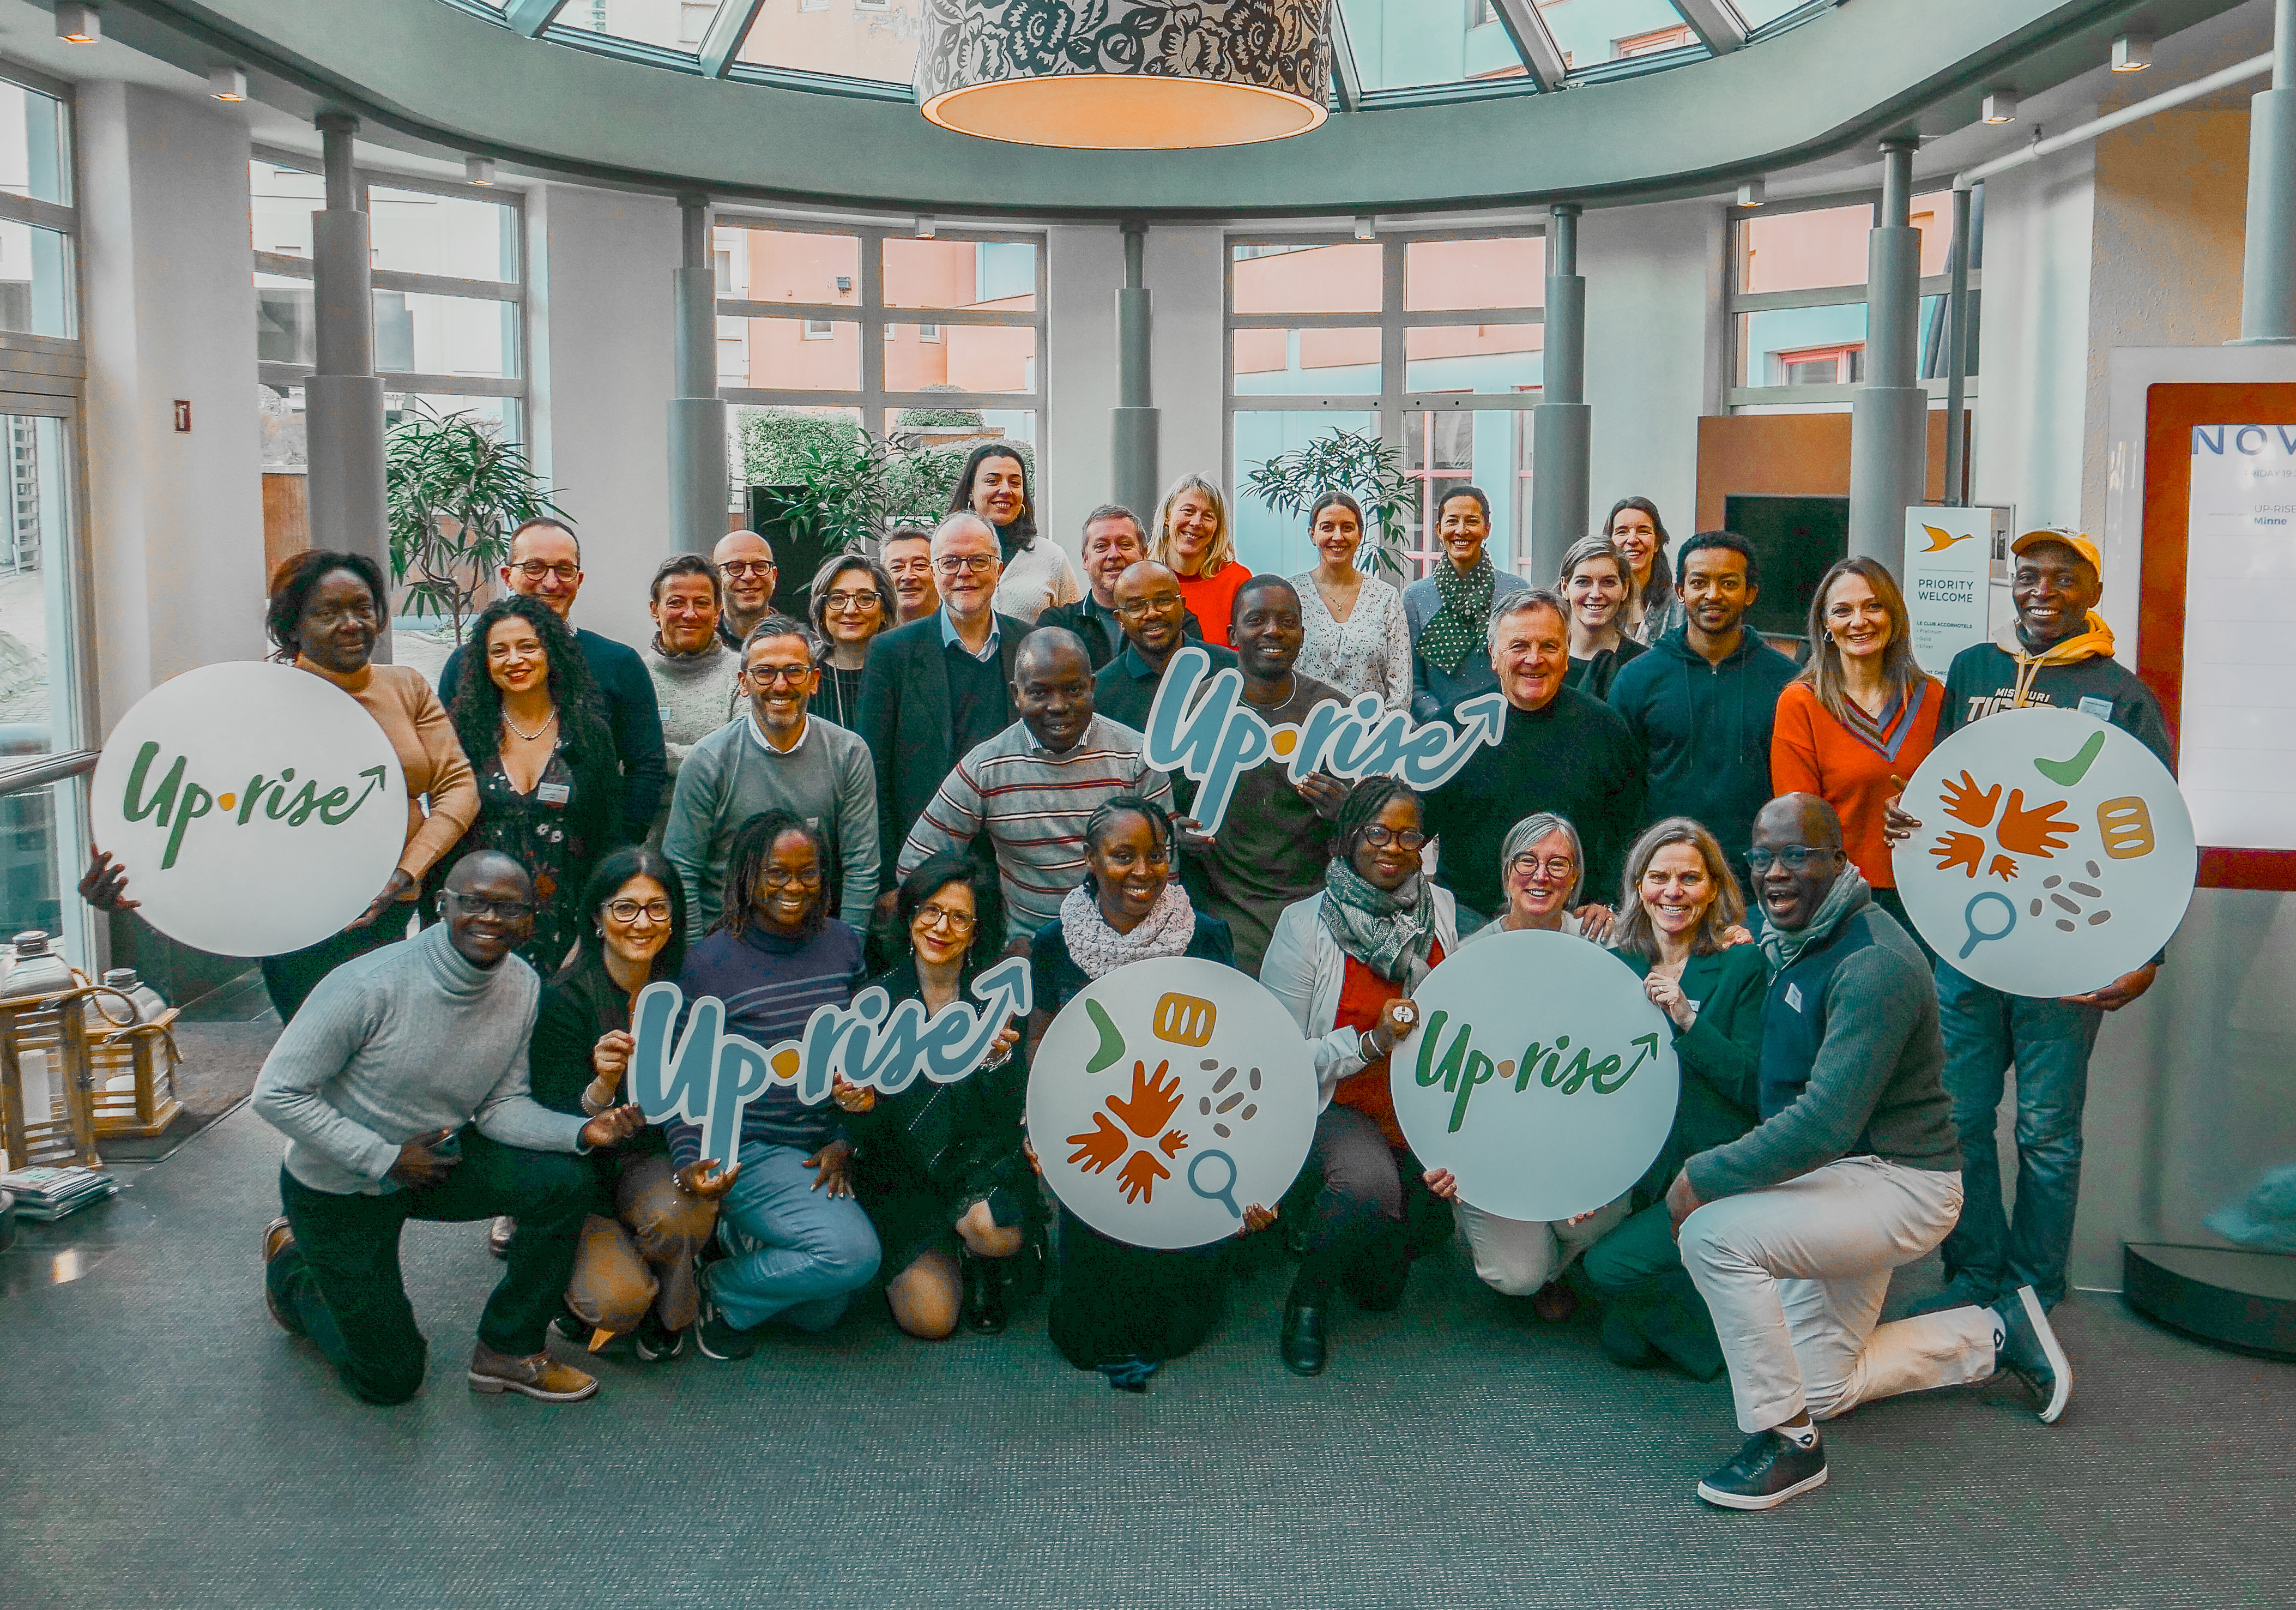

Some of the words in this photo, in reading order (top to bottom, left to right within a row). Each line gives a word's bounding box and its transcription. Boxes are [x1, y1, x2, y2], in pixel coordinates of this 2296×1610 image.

[2255, 505, 2296, 513] UP-RISE
[2254, 516, 2287, 524] Minne
[1918, 579, 1974, 590] PRIORITY
[1918, 591, 1973, 603] WELCOME
[1995, 688, 2051, 703] MISURI
